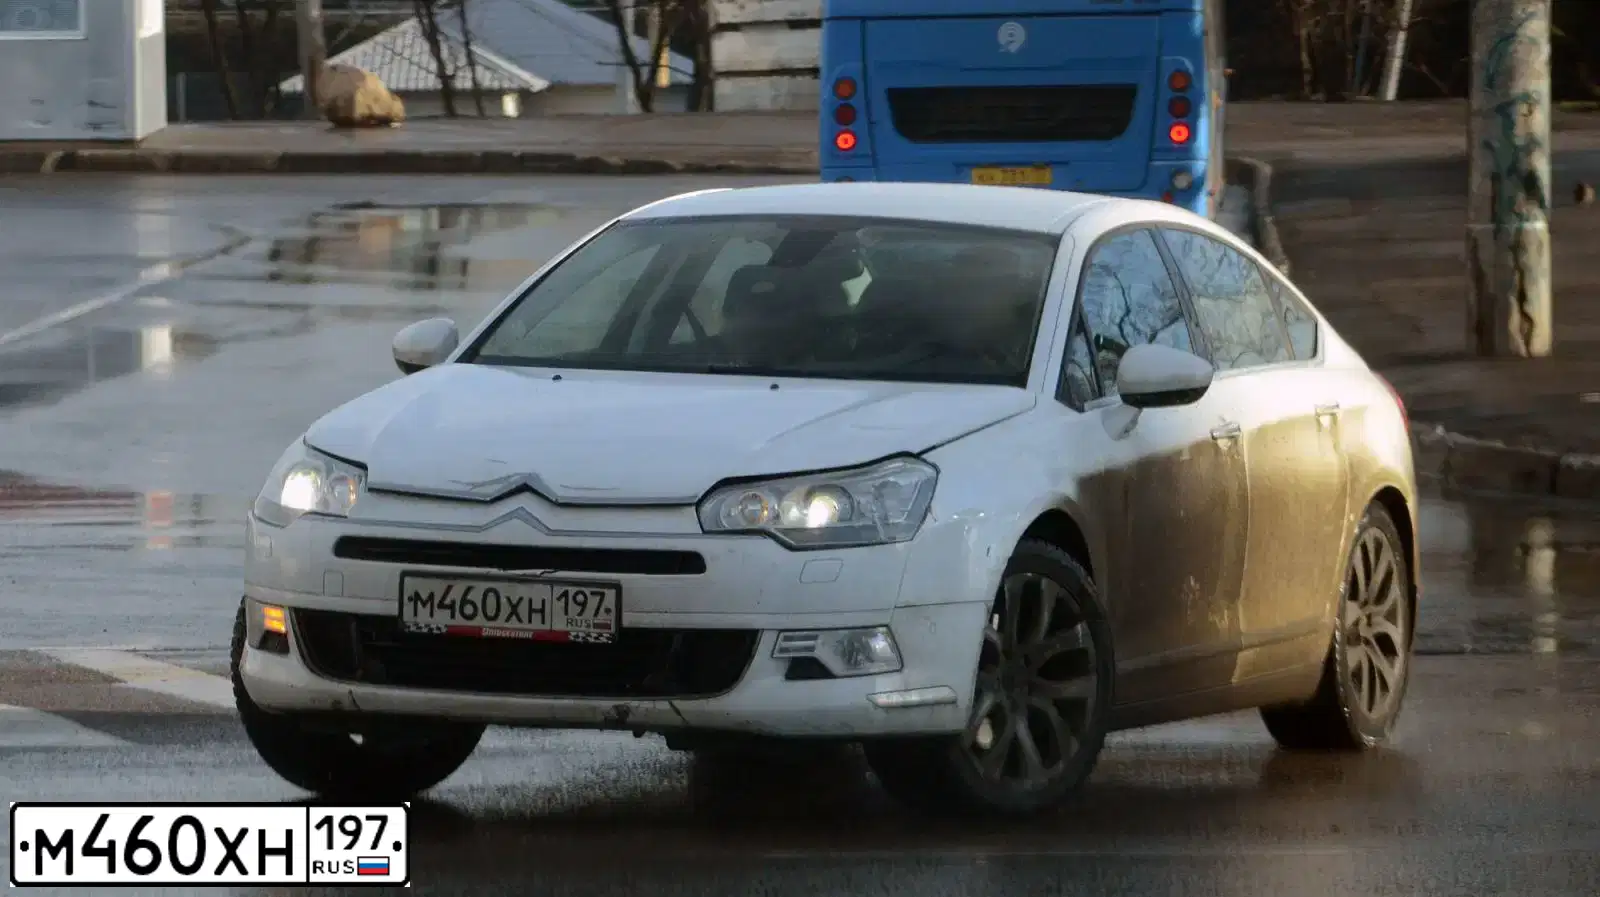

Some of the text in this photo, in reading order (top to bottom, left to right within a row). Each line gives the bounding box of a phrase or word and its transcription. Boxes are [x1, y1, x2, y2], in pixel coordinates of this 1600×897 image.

[412, 584, 606, 625] М460ХН 197
[566, 617, 592, 629] RUS
